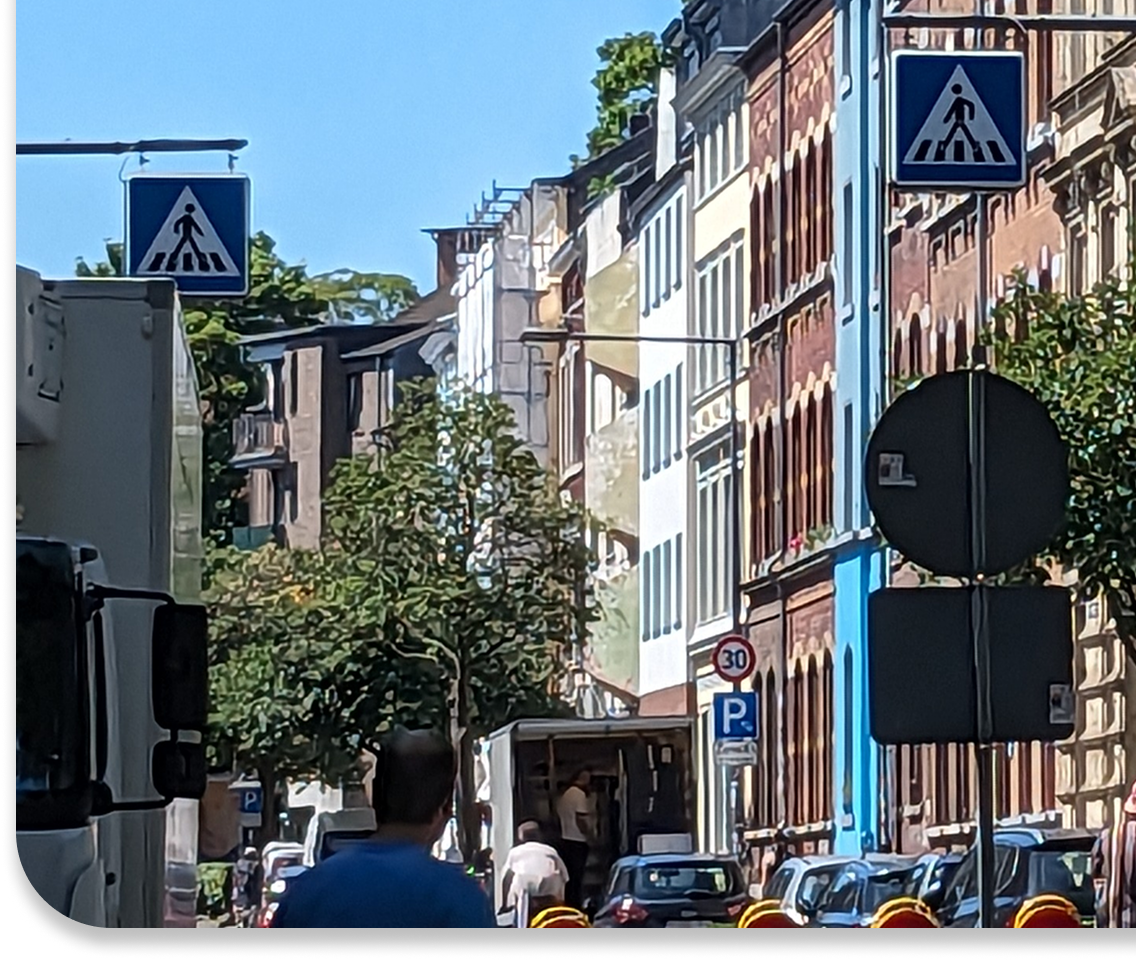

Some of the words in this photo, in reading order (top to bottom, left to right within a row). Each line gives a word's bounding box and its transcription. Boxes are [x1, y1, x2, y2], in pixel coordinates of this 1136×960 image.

[722, 649, 747, 669] 30
[723, 697, 747, 734] P
[244, 791, 257, 810] P
